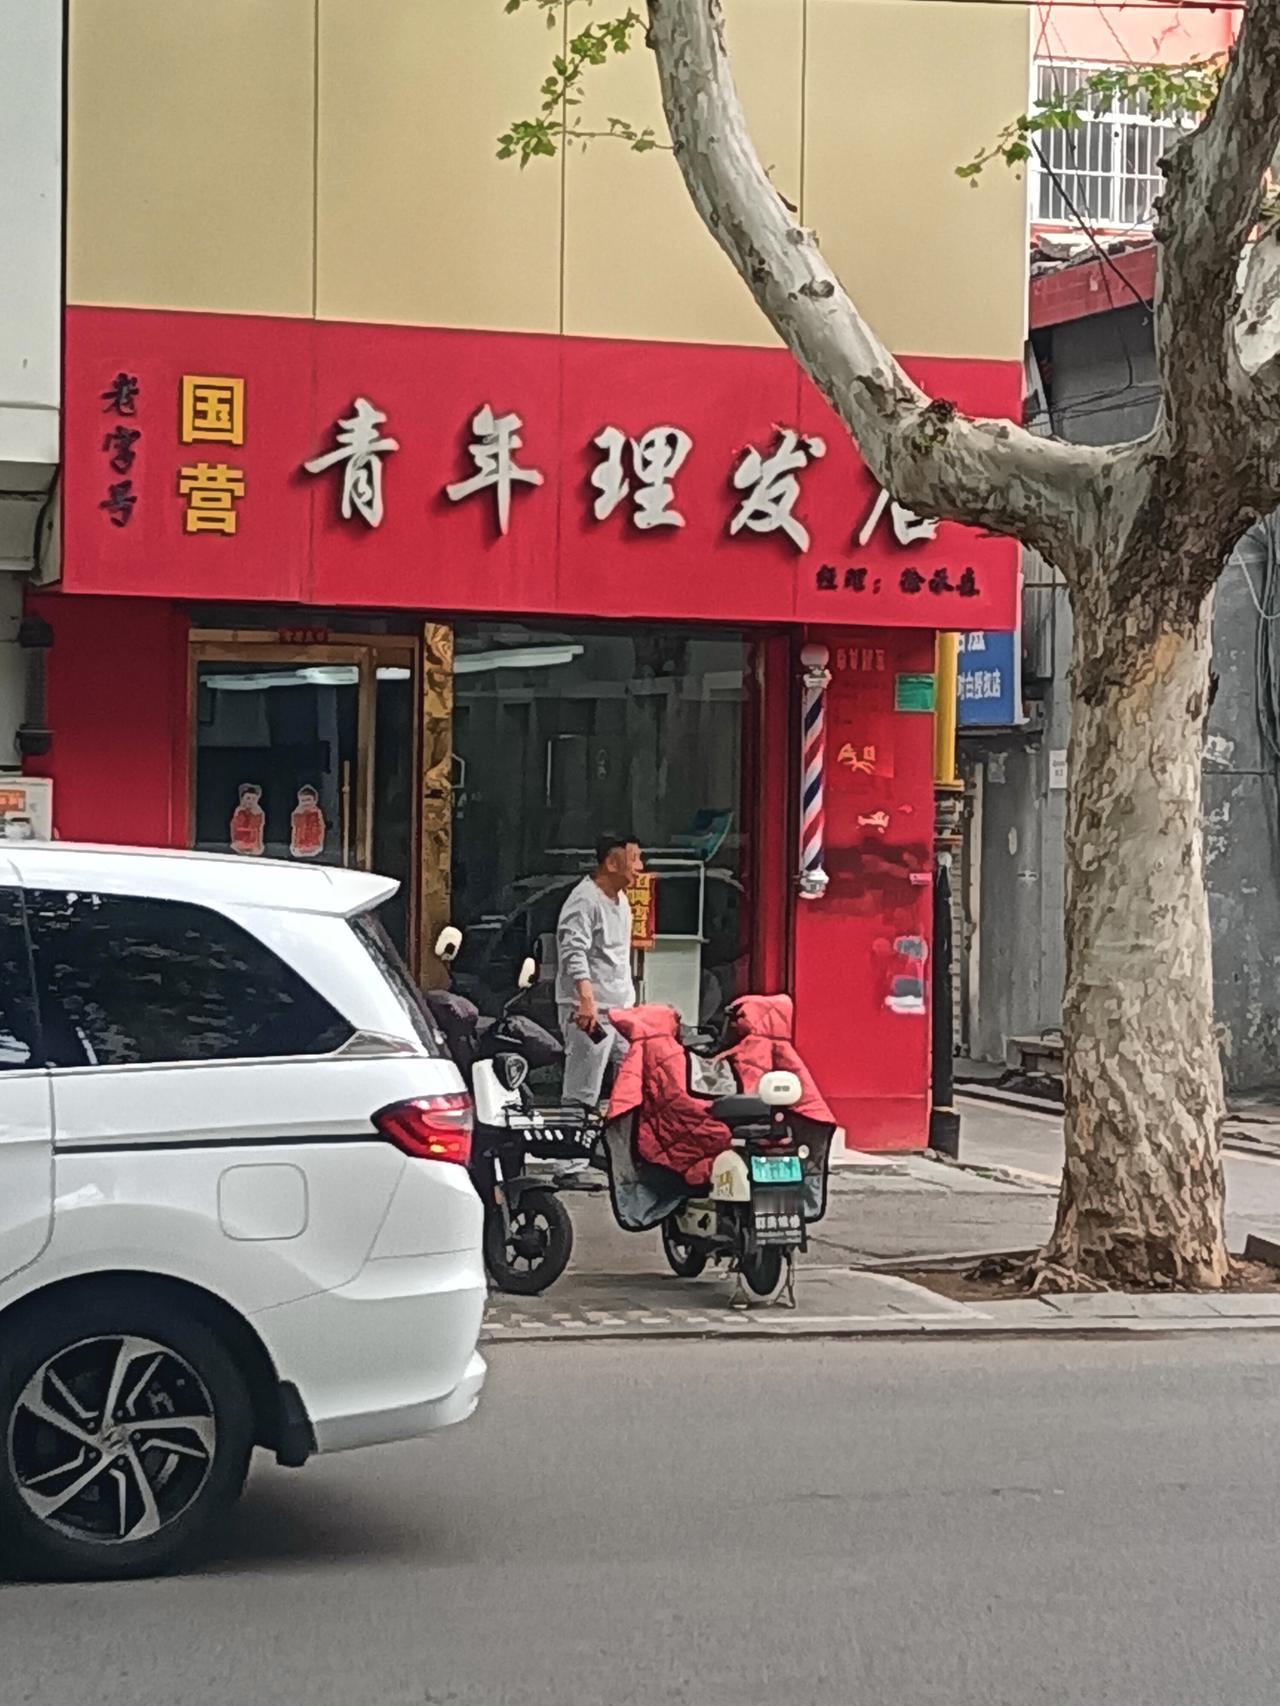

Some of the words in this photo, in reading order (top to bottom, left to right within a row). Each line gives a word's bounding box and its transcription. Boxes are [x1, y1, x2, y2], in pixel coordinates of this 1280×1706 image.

[100, 372, 141, 527] 老字号
[179, 374, 245, 534] 国营
